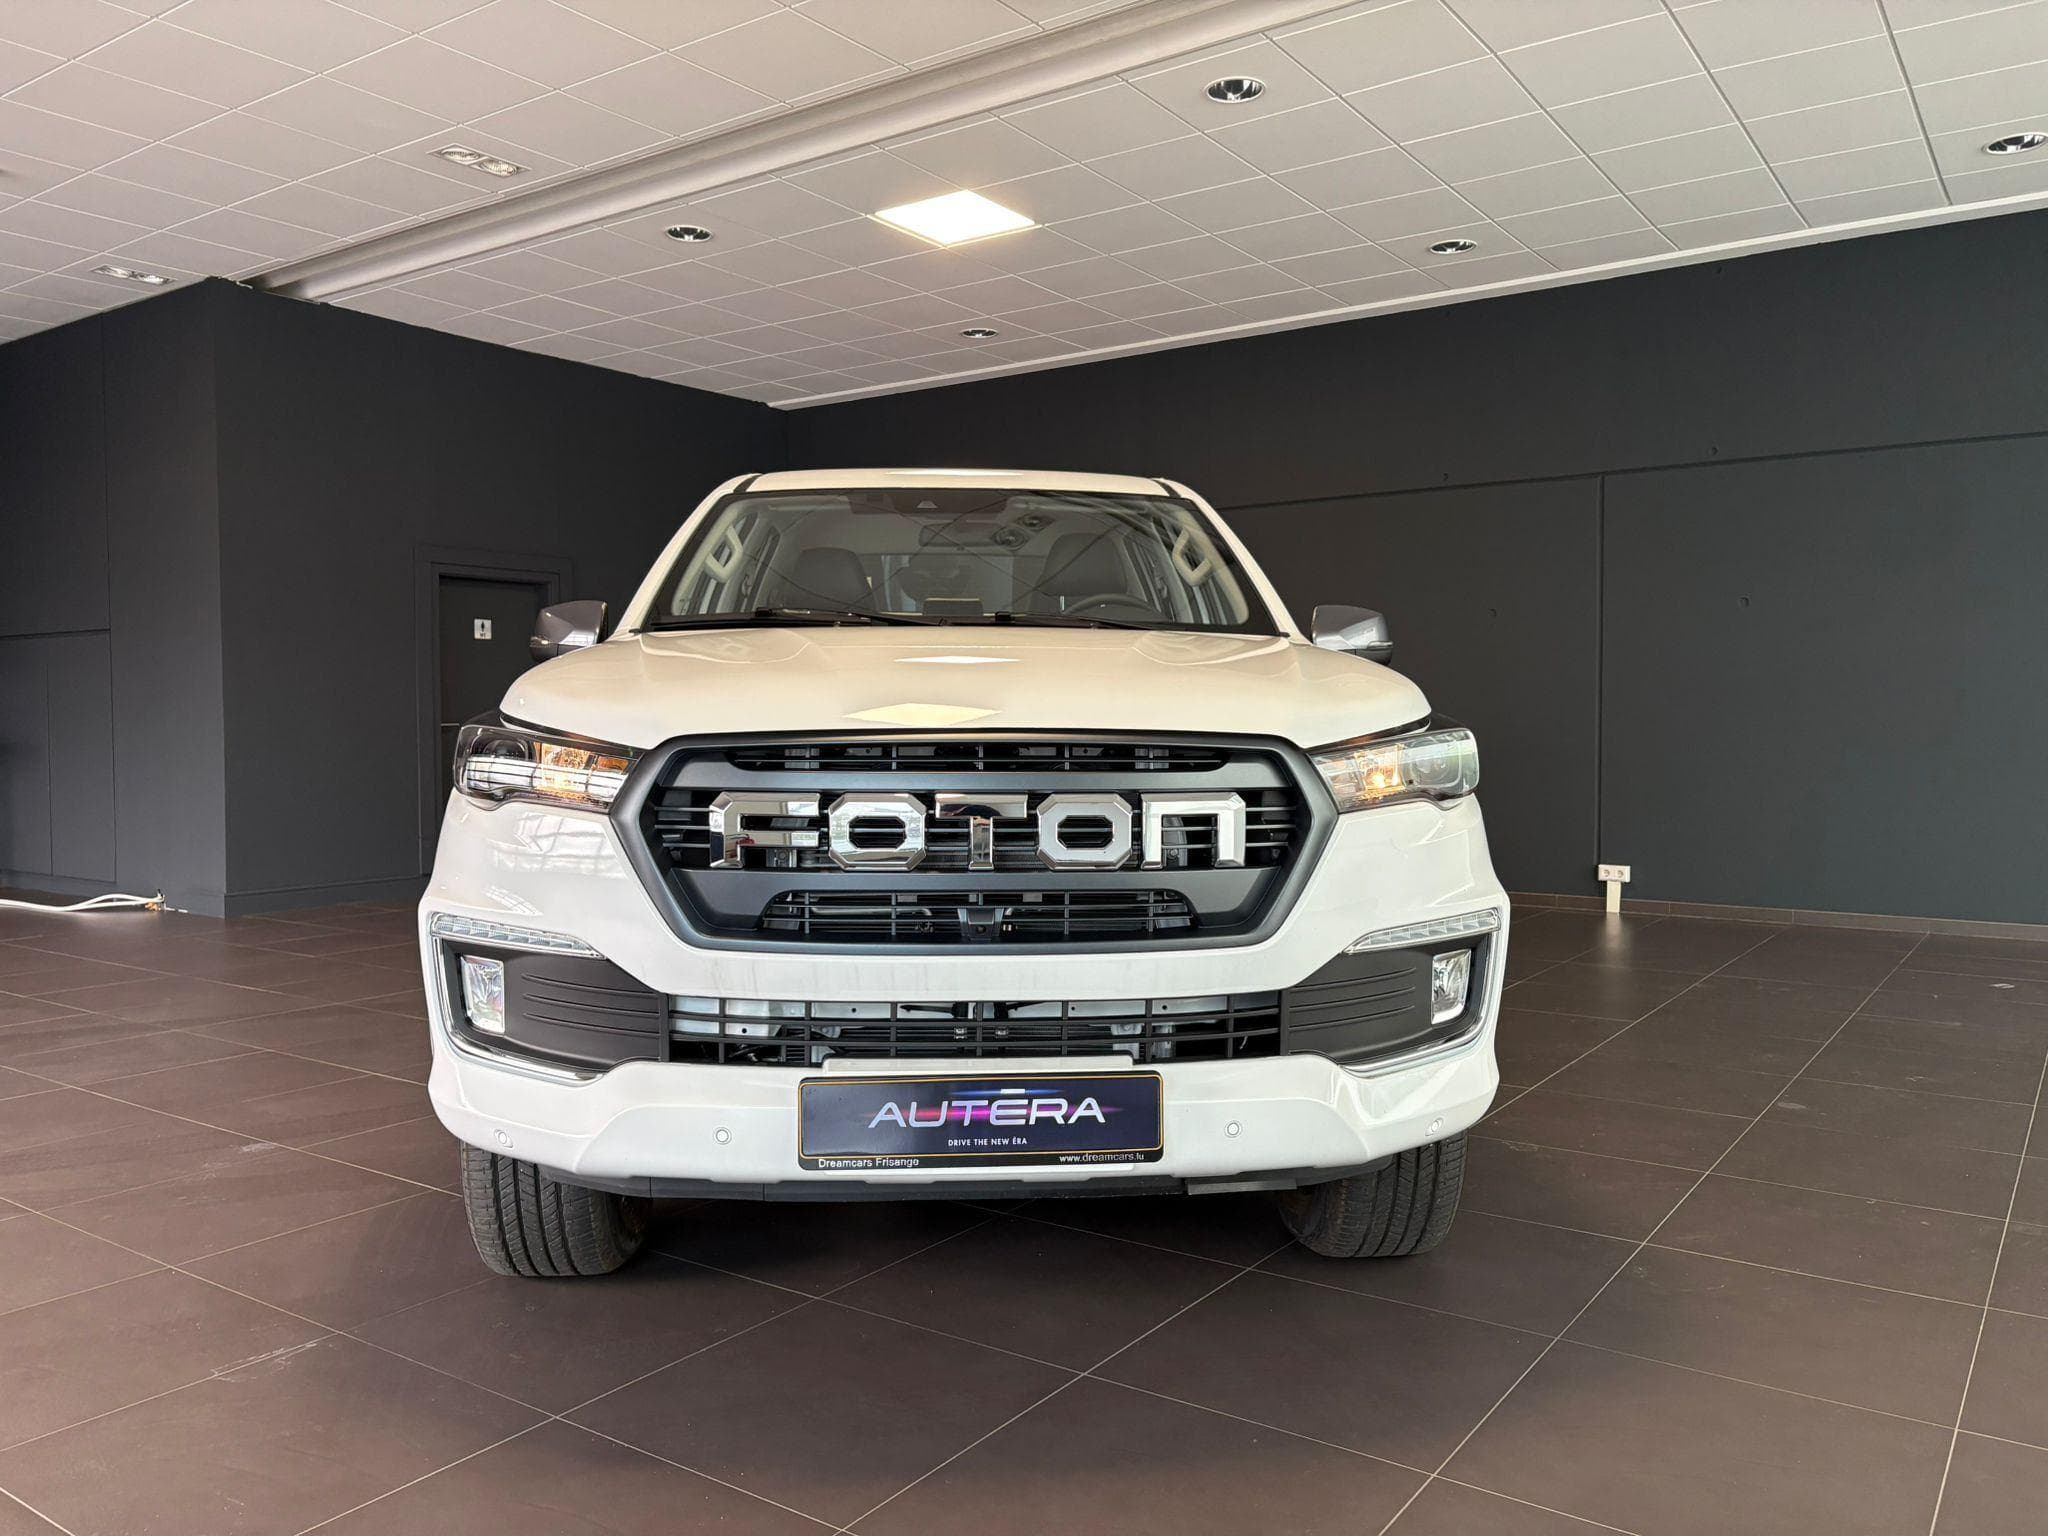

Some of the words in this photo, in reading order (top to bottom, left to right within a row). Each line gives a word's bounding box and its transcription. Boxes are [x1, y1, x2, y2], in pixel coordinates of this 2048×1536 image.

[974, 1138, 988, 1146] THE
[1059, 1152, 1144, 1162] www.dreamcars.lu
[818, 1158, 872, 1168] Dreamcars
